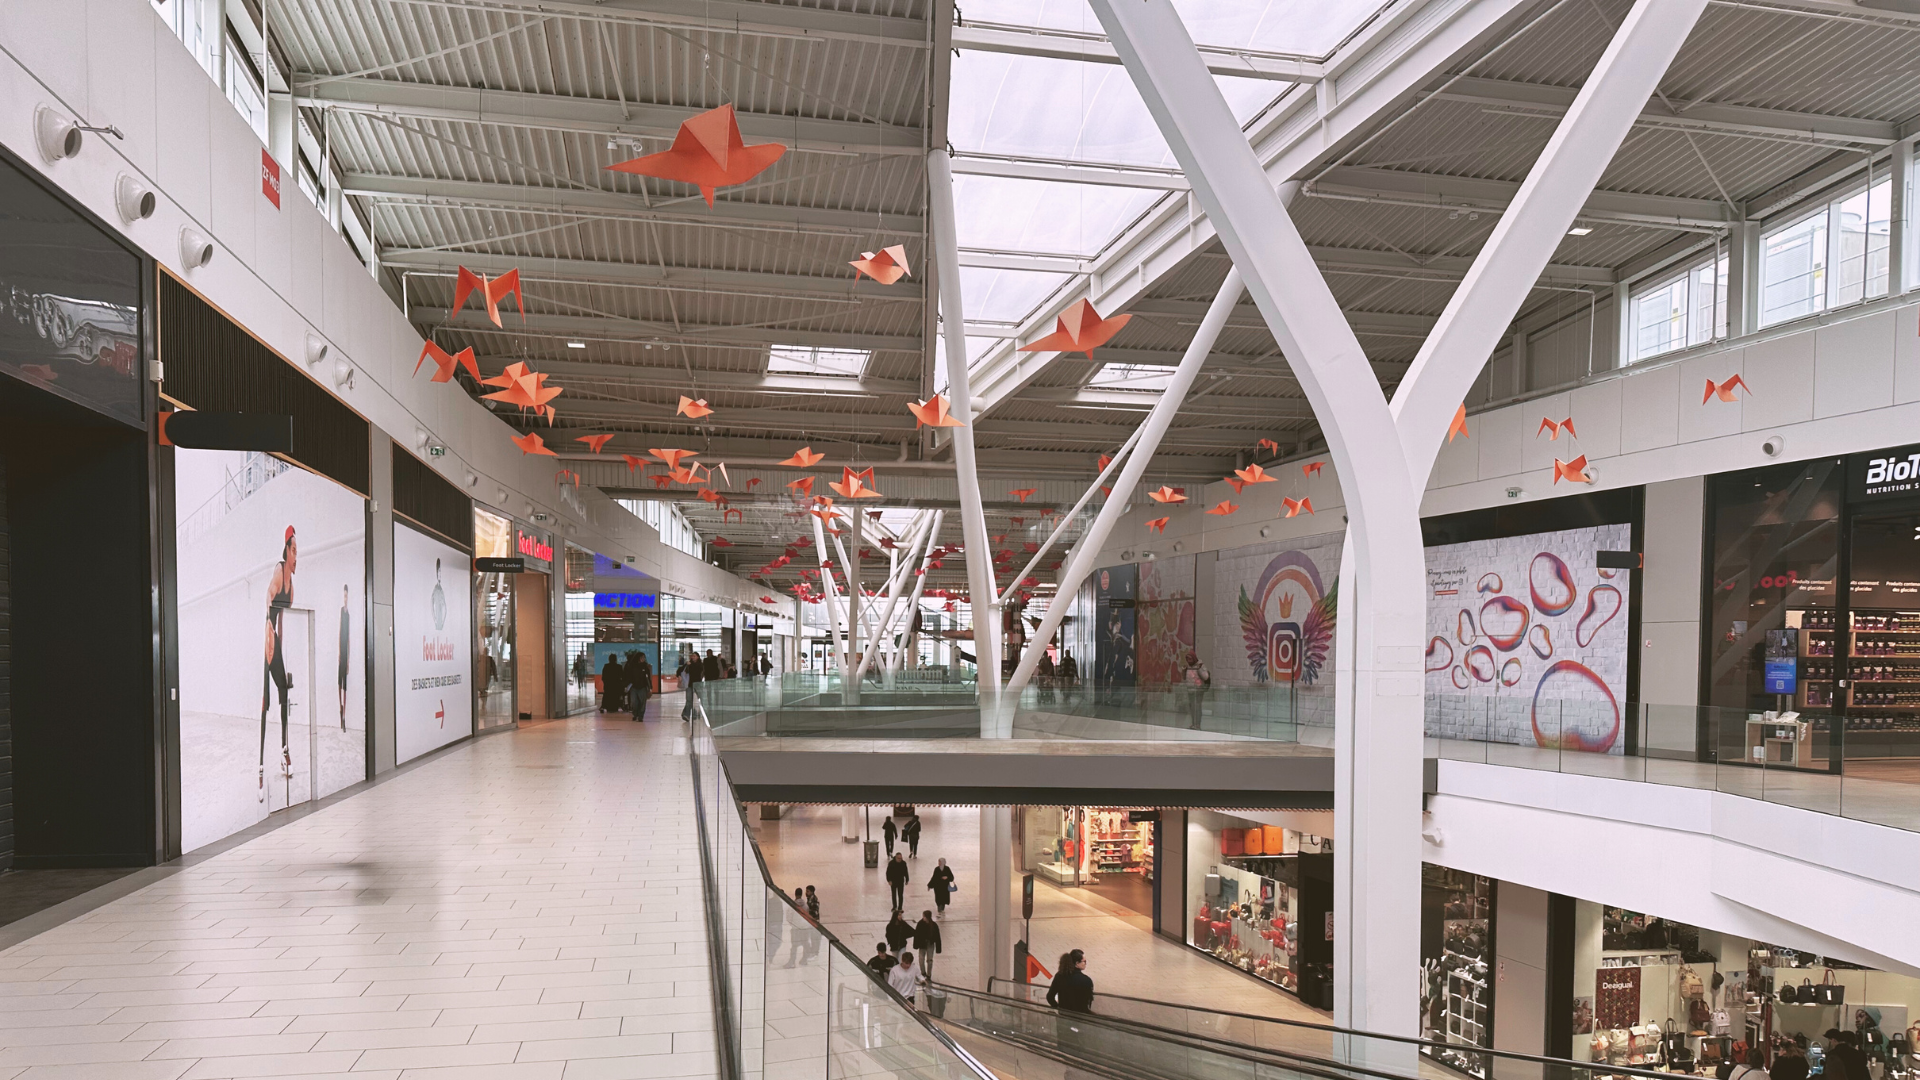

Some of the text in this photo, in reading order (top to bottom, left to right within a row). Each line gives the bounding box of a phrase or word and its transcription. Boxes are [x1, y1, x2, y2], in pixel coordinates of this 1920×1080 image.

[1866, 453, 1920, 484] BioT
[1866, 483, 1911, 495] NUTRITION
[518, 530, 553, 562] Foot Locker
[593, 592, 656, 609] ACTION
[423, 635, 454, 661] Foot Locker
